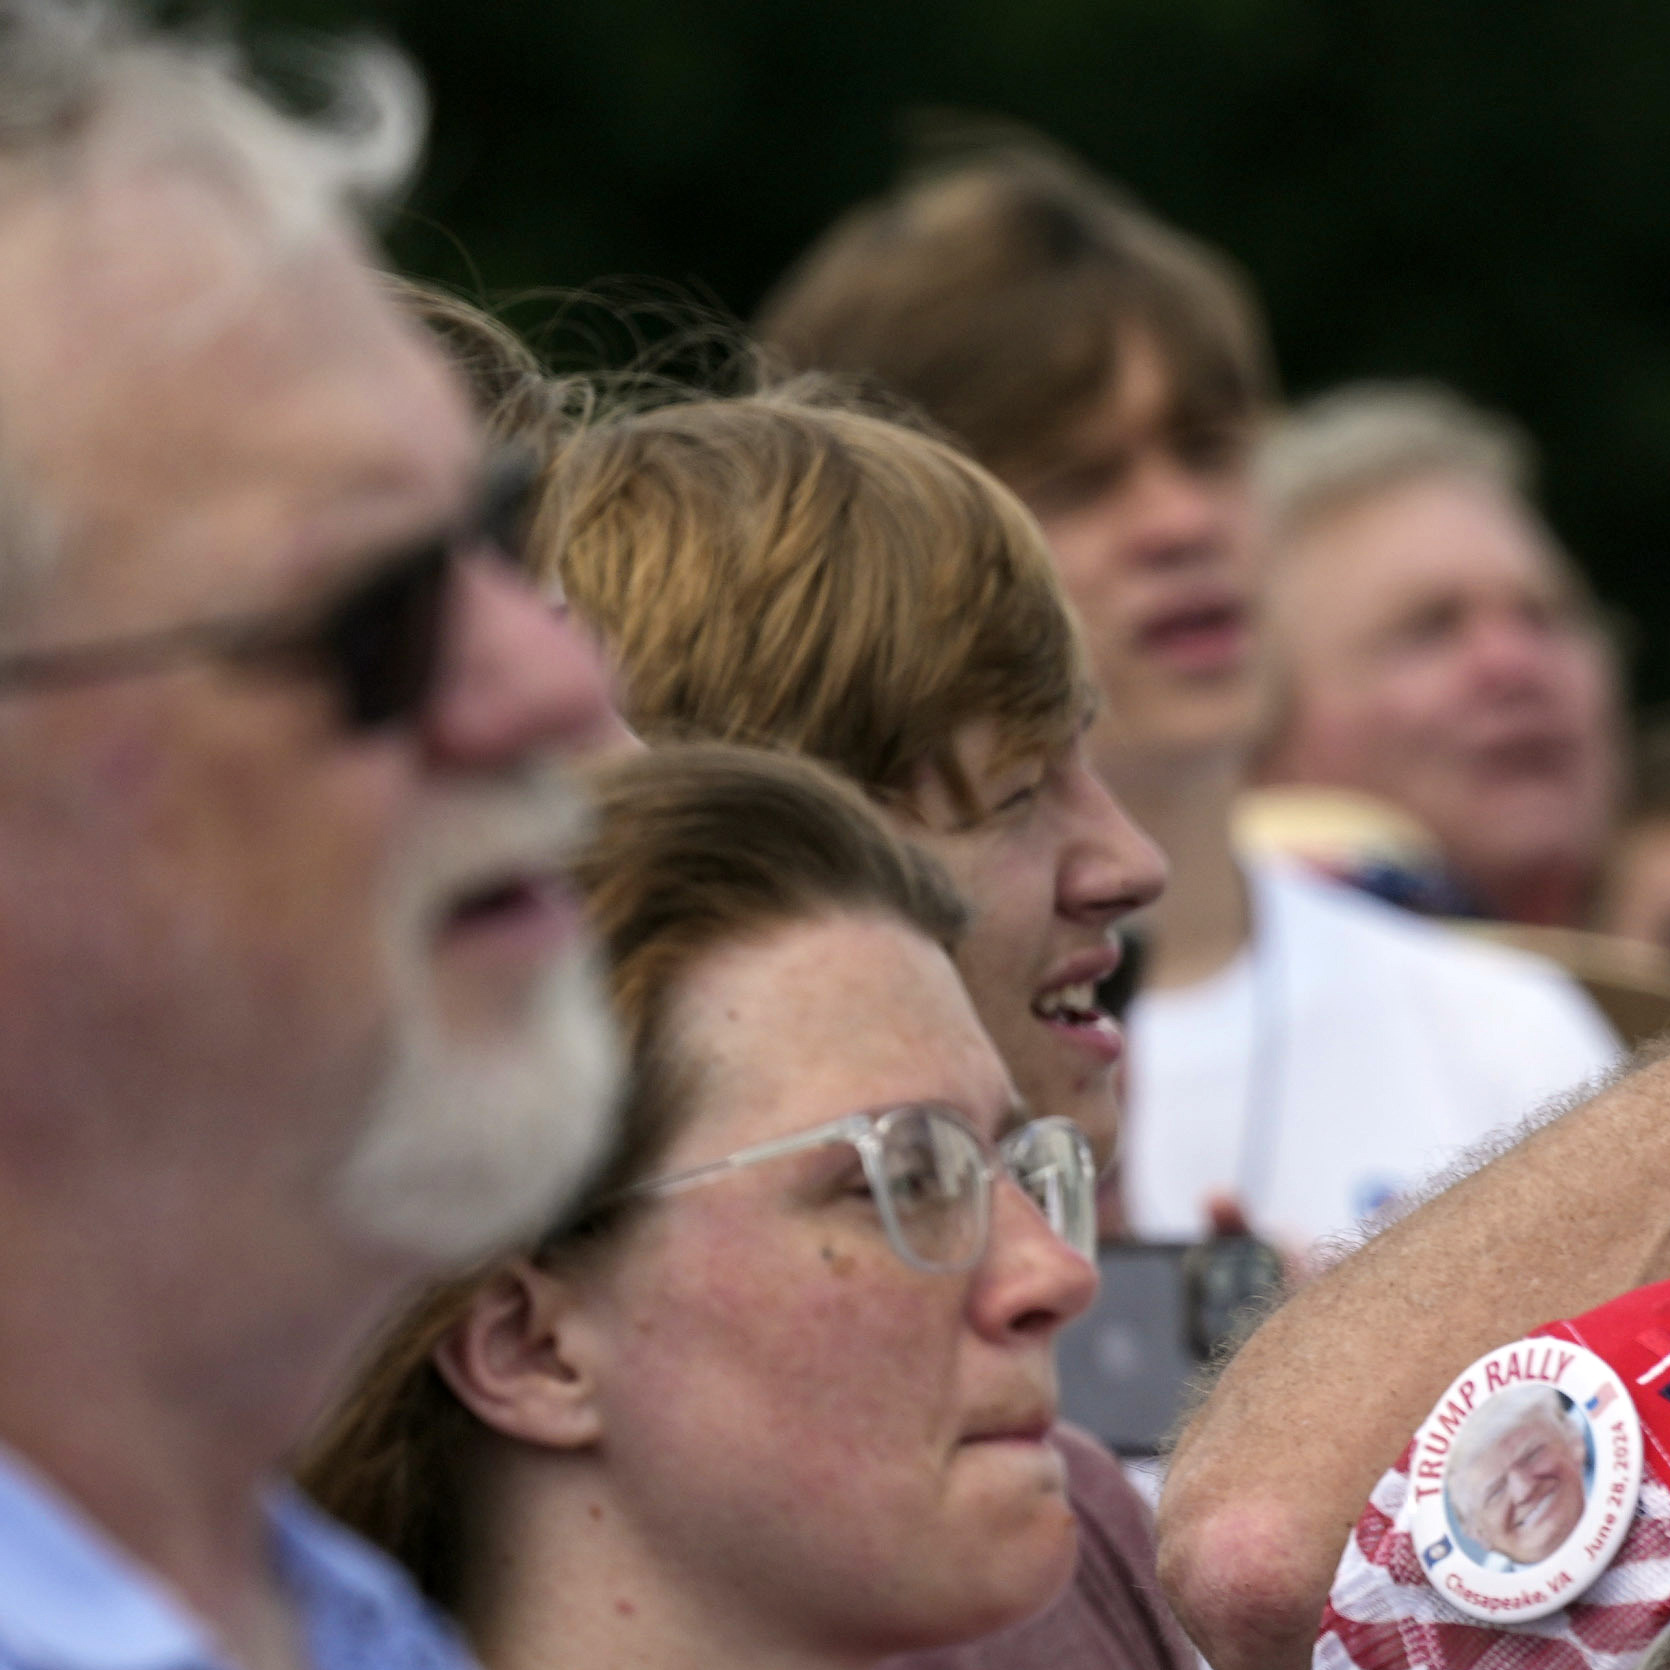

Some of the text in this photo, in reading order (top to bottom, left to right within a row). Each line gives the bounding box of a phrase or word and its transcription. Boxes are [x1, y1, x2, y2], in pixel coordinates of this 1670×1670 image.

[1416, 1348, 1576, 1504] TRUMP RALLY
[1584, 1515, 1615, 1561] June
[1610, 1420, 1629, 1471] 2024
[1546, 1570, 1574, 1594] VA
